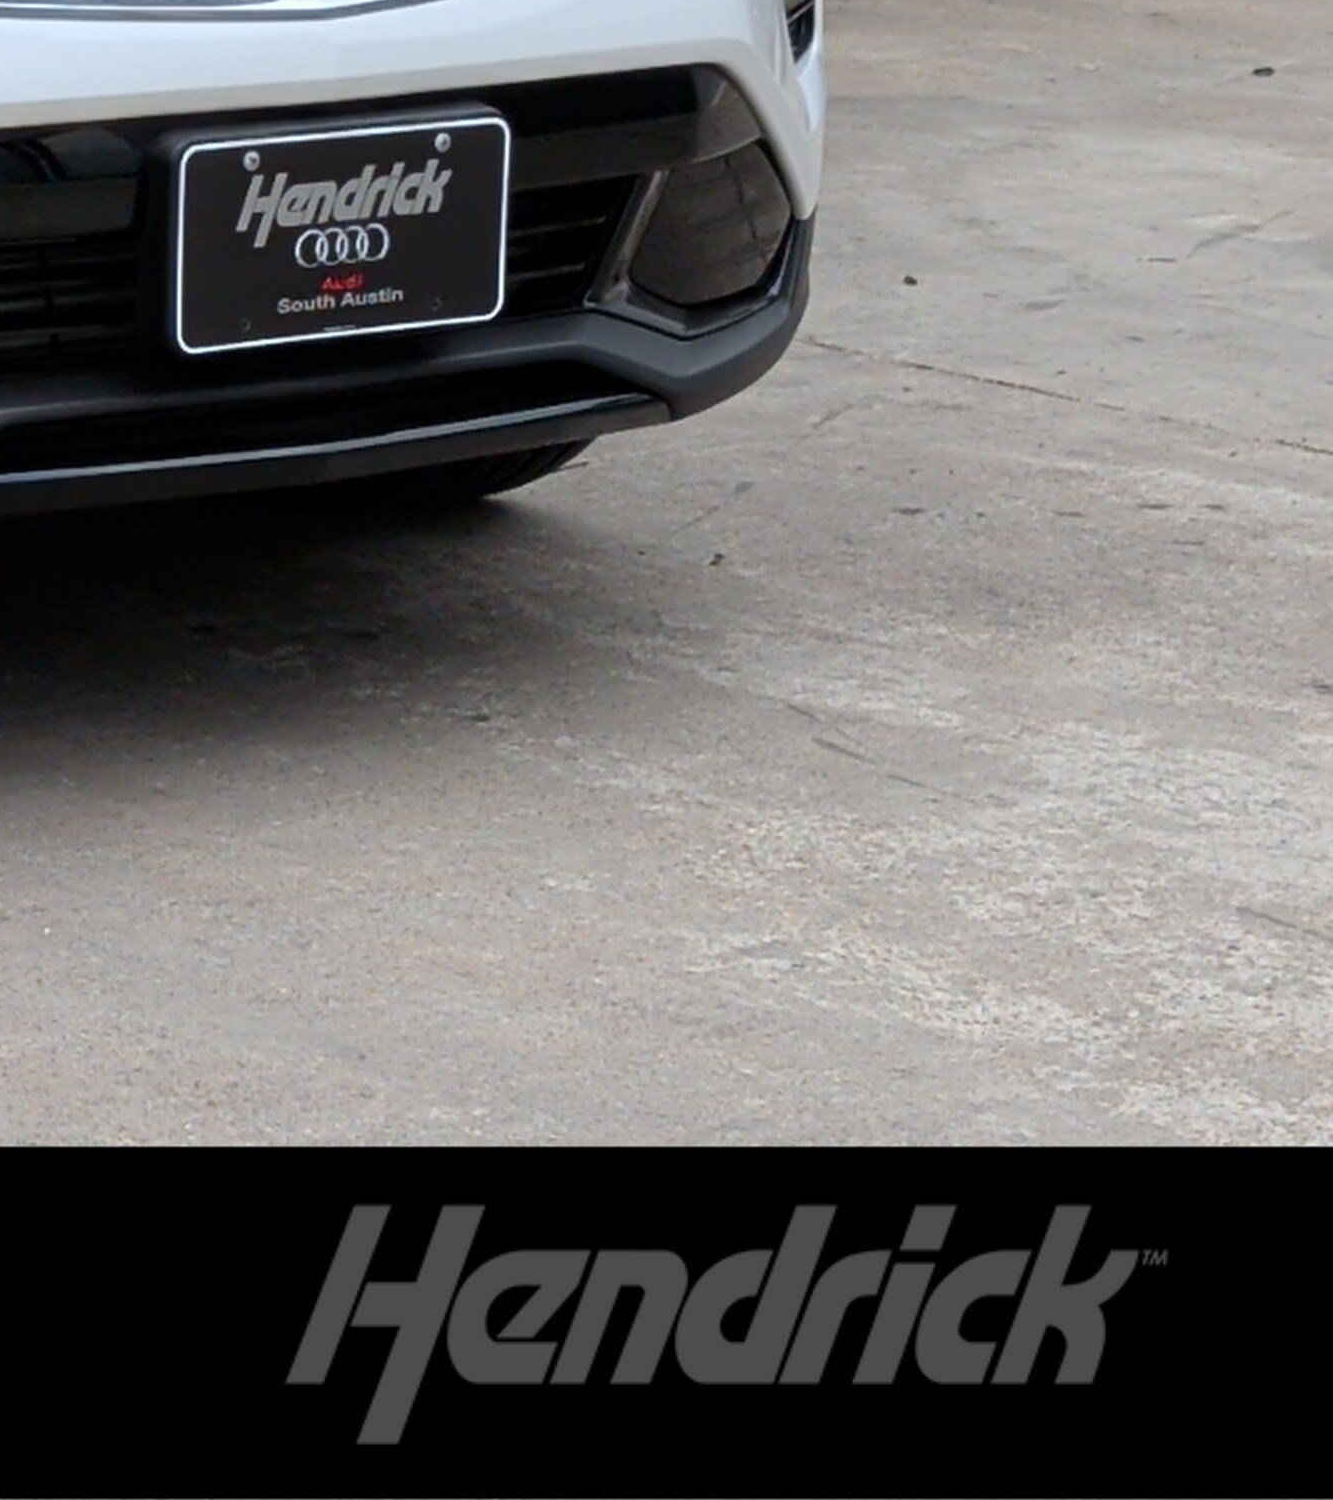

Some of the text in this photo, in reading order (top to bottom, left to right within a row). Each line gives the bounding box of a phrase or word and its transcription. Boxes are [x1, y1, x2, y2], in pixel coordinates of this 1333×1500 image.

[235, 158, 453, 248] Hendrick
[321, 274, 365, 291] Audi
[277, 287, 404, 315] South Austin
